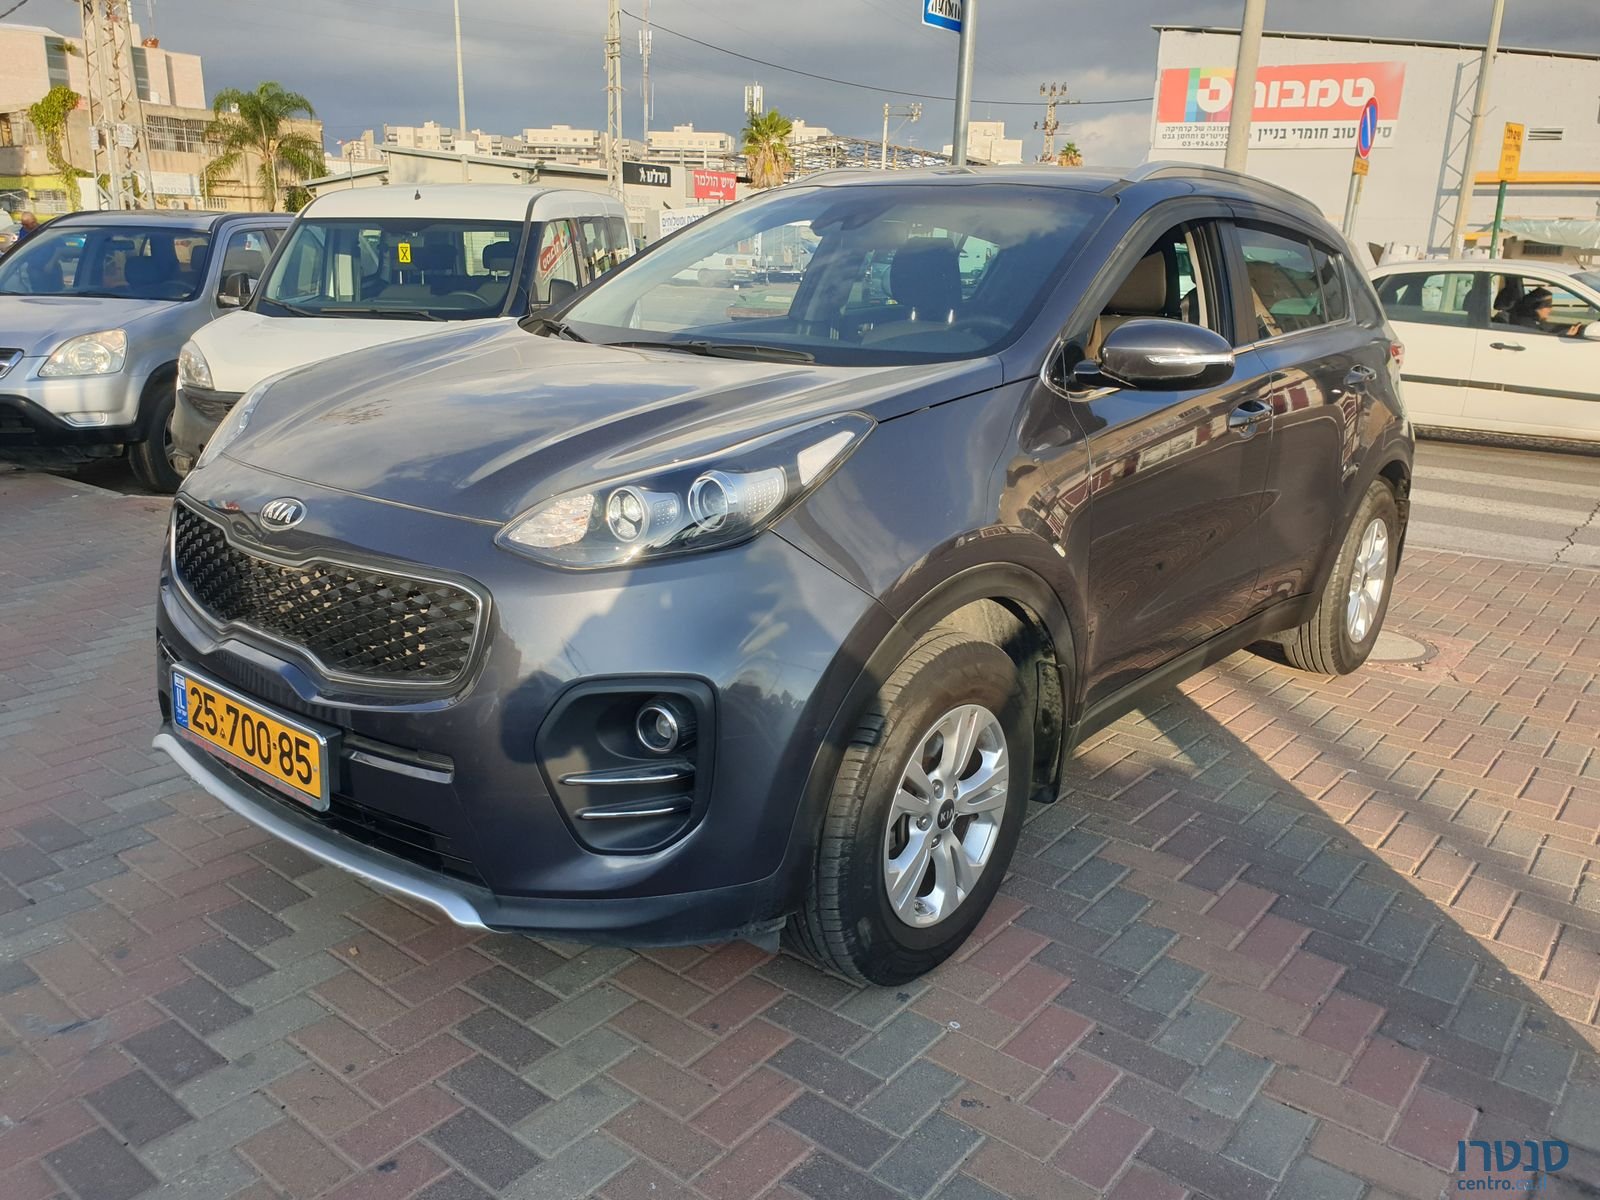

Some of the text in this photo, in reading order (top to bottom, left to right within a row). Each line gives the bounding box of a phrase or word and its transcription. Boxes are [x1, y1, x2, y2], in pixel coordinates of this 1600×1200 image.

[1258, 128, 1287, 142] בניין
[1291, 127, 1328, 139] חומרי
[1332, 127, 1357, 139] טוב
[694, 171, 736, 189] שיש הולמר
[263, 501, 297, 524] KIA
